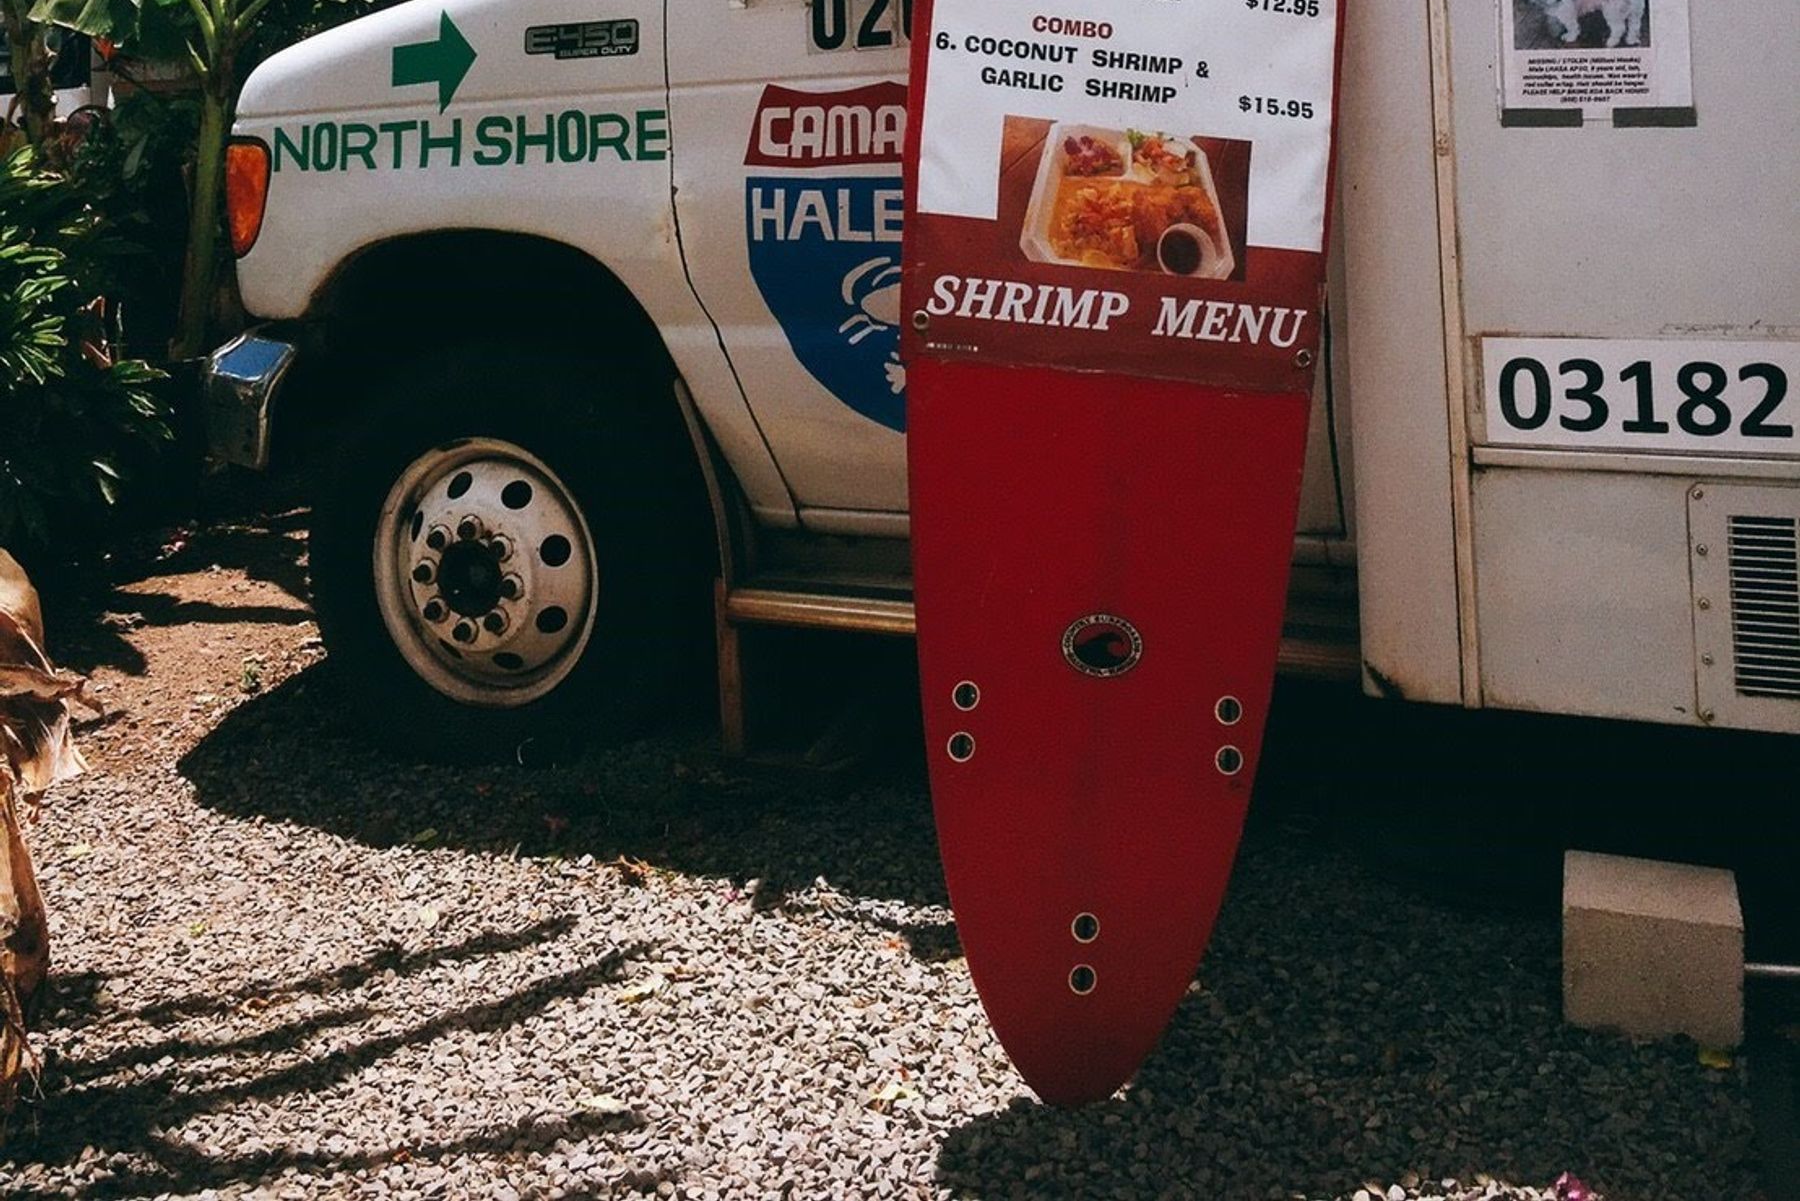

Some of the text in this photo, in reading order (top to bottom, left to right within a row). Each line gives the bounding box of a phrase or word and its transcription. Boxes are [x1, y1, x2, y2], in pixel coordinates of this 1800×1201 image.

[526, 21, 638, 52] E-450
[600, 45, 632, 55] DUTY
[1032, 15, 1114, 39] COMBO
[935, 31, 1210, 79] 6. COCONUT SHRIMP &
[980, 67, 1314, 120] GARLIC SHRIMP $15.95
[273, 108, 667, 172] NORTH SHORE
[925, 274, 1307, 349] SHRIMP MENU
[1498, 356, 1794, 438] 03182
